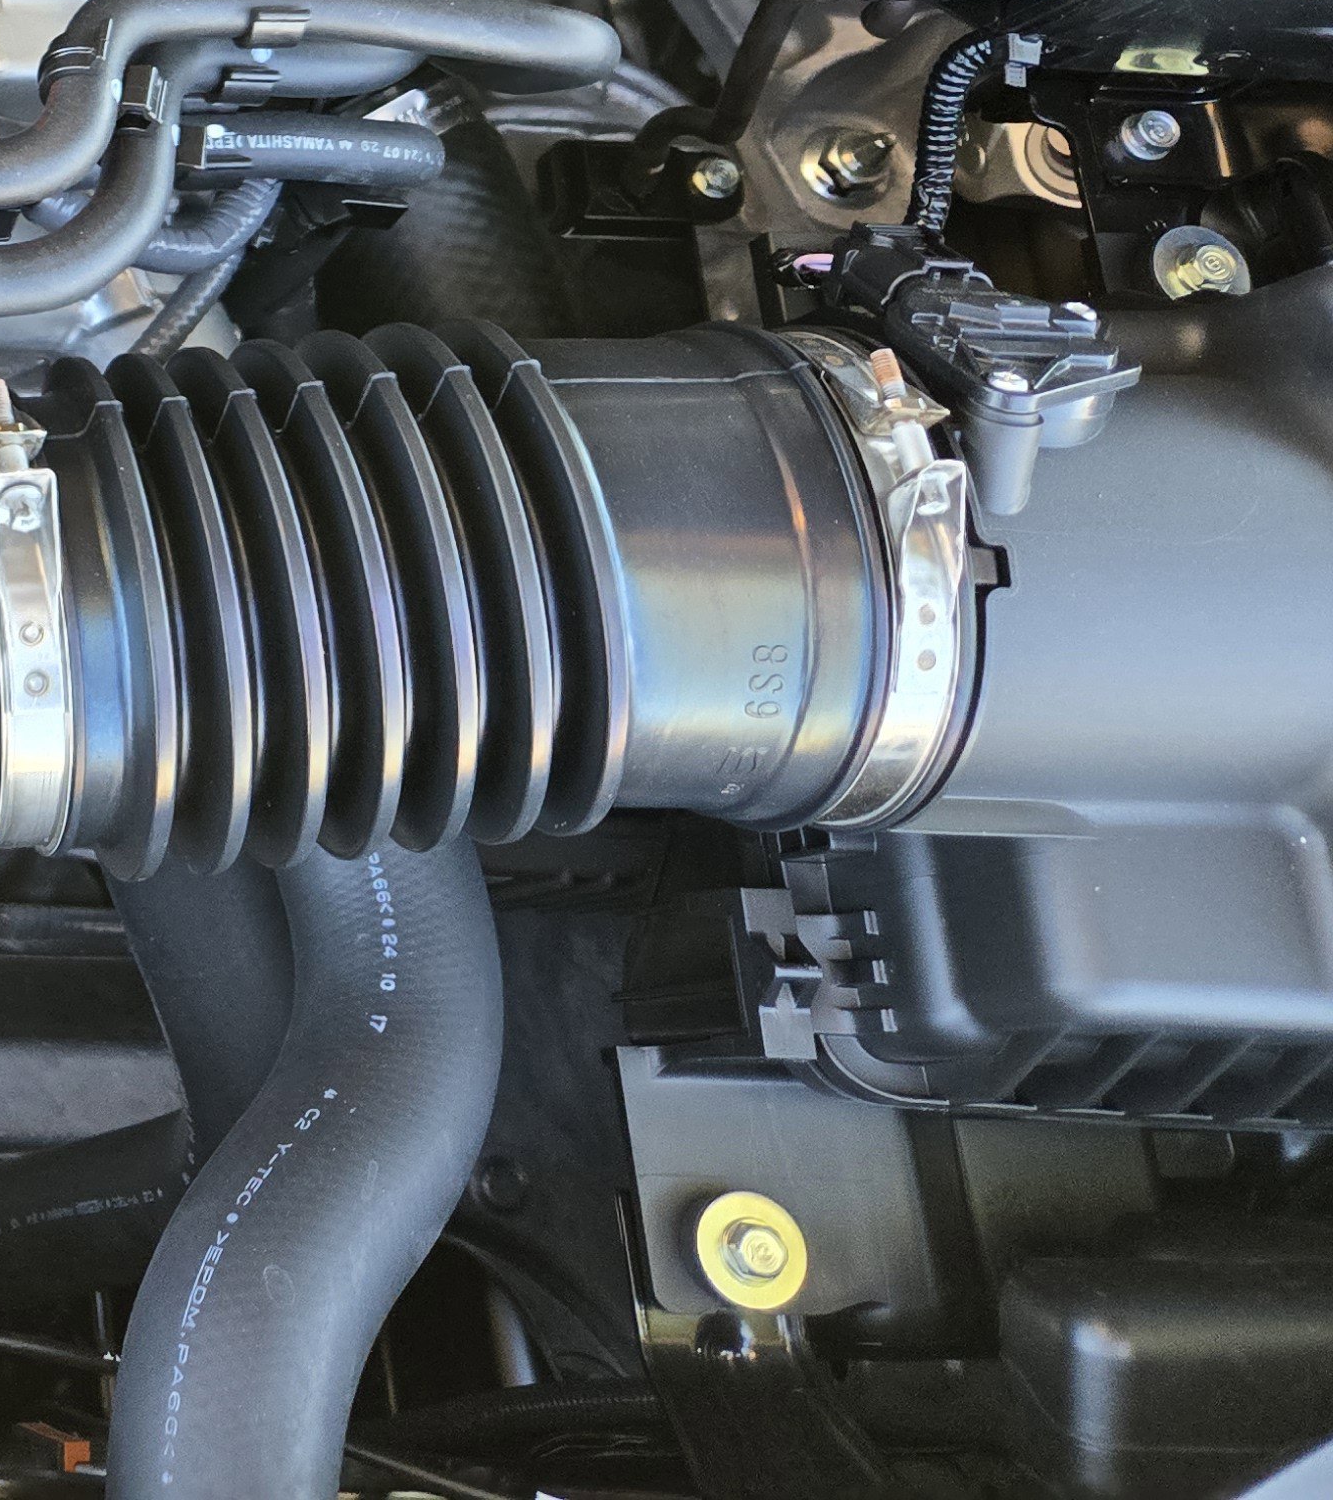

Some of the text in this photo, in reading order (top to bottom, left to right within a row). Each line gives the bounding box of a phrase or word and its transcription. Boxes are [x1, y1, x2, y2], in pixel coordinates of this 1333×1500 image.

[247, 133, 334, 151] YAMASHITA
[744, 644, 789, 720] 6S8
[382, 933, 399, 959] 24
[380, 973, 397, 992] 10
[369, 1014, 389, 1034] 17
[293, 1107, 321, 1132] C2
[235, 1142, 293, 1207] Y-TEC
